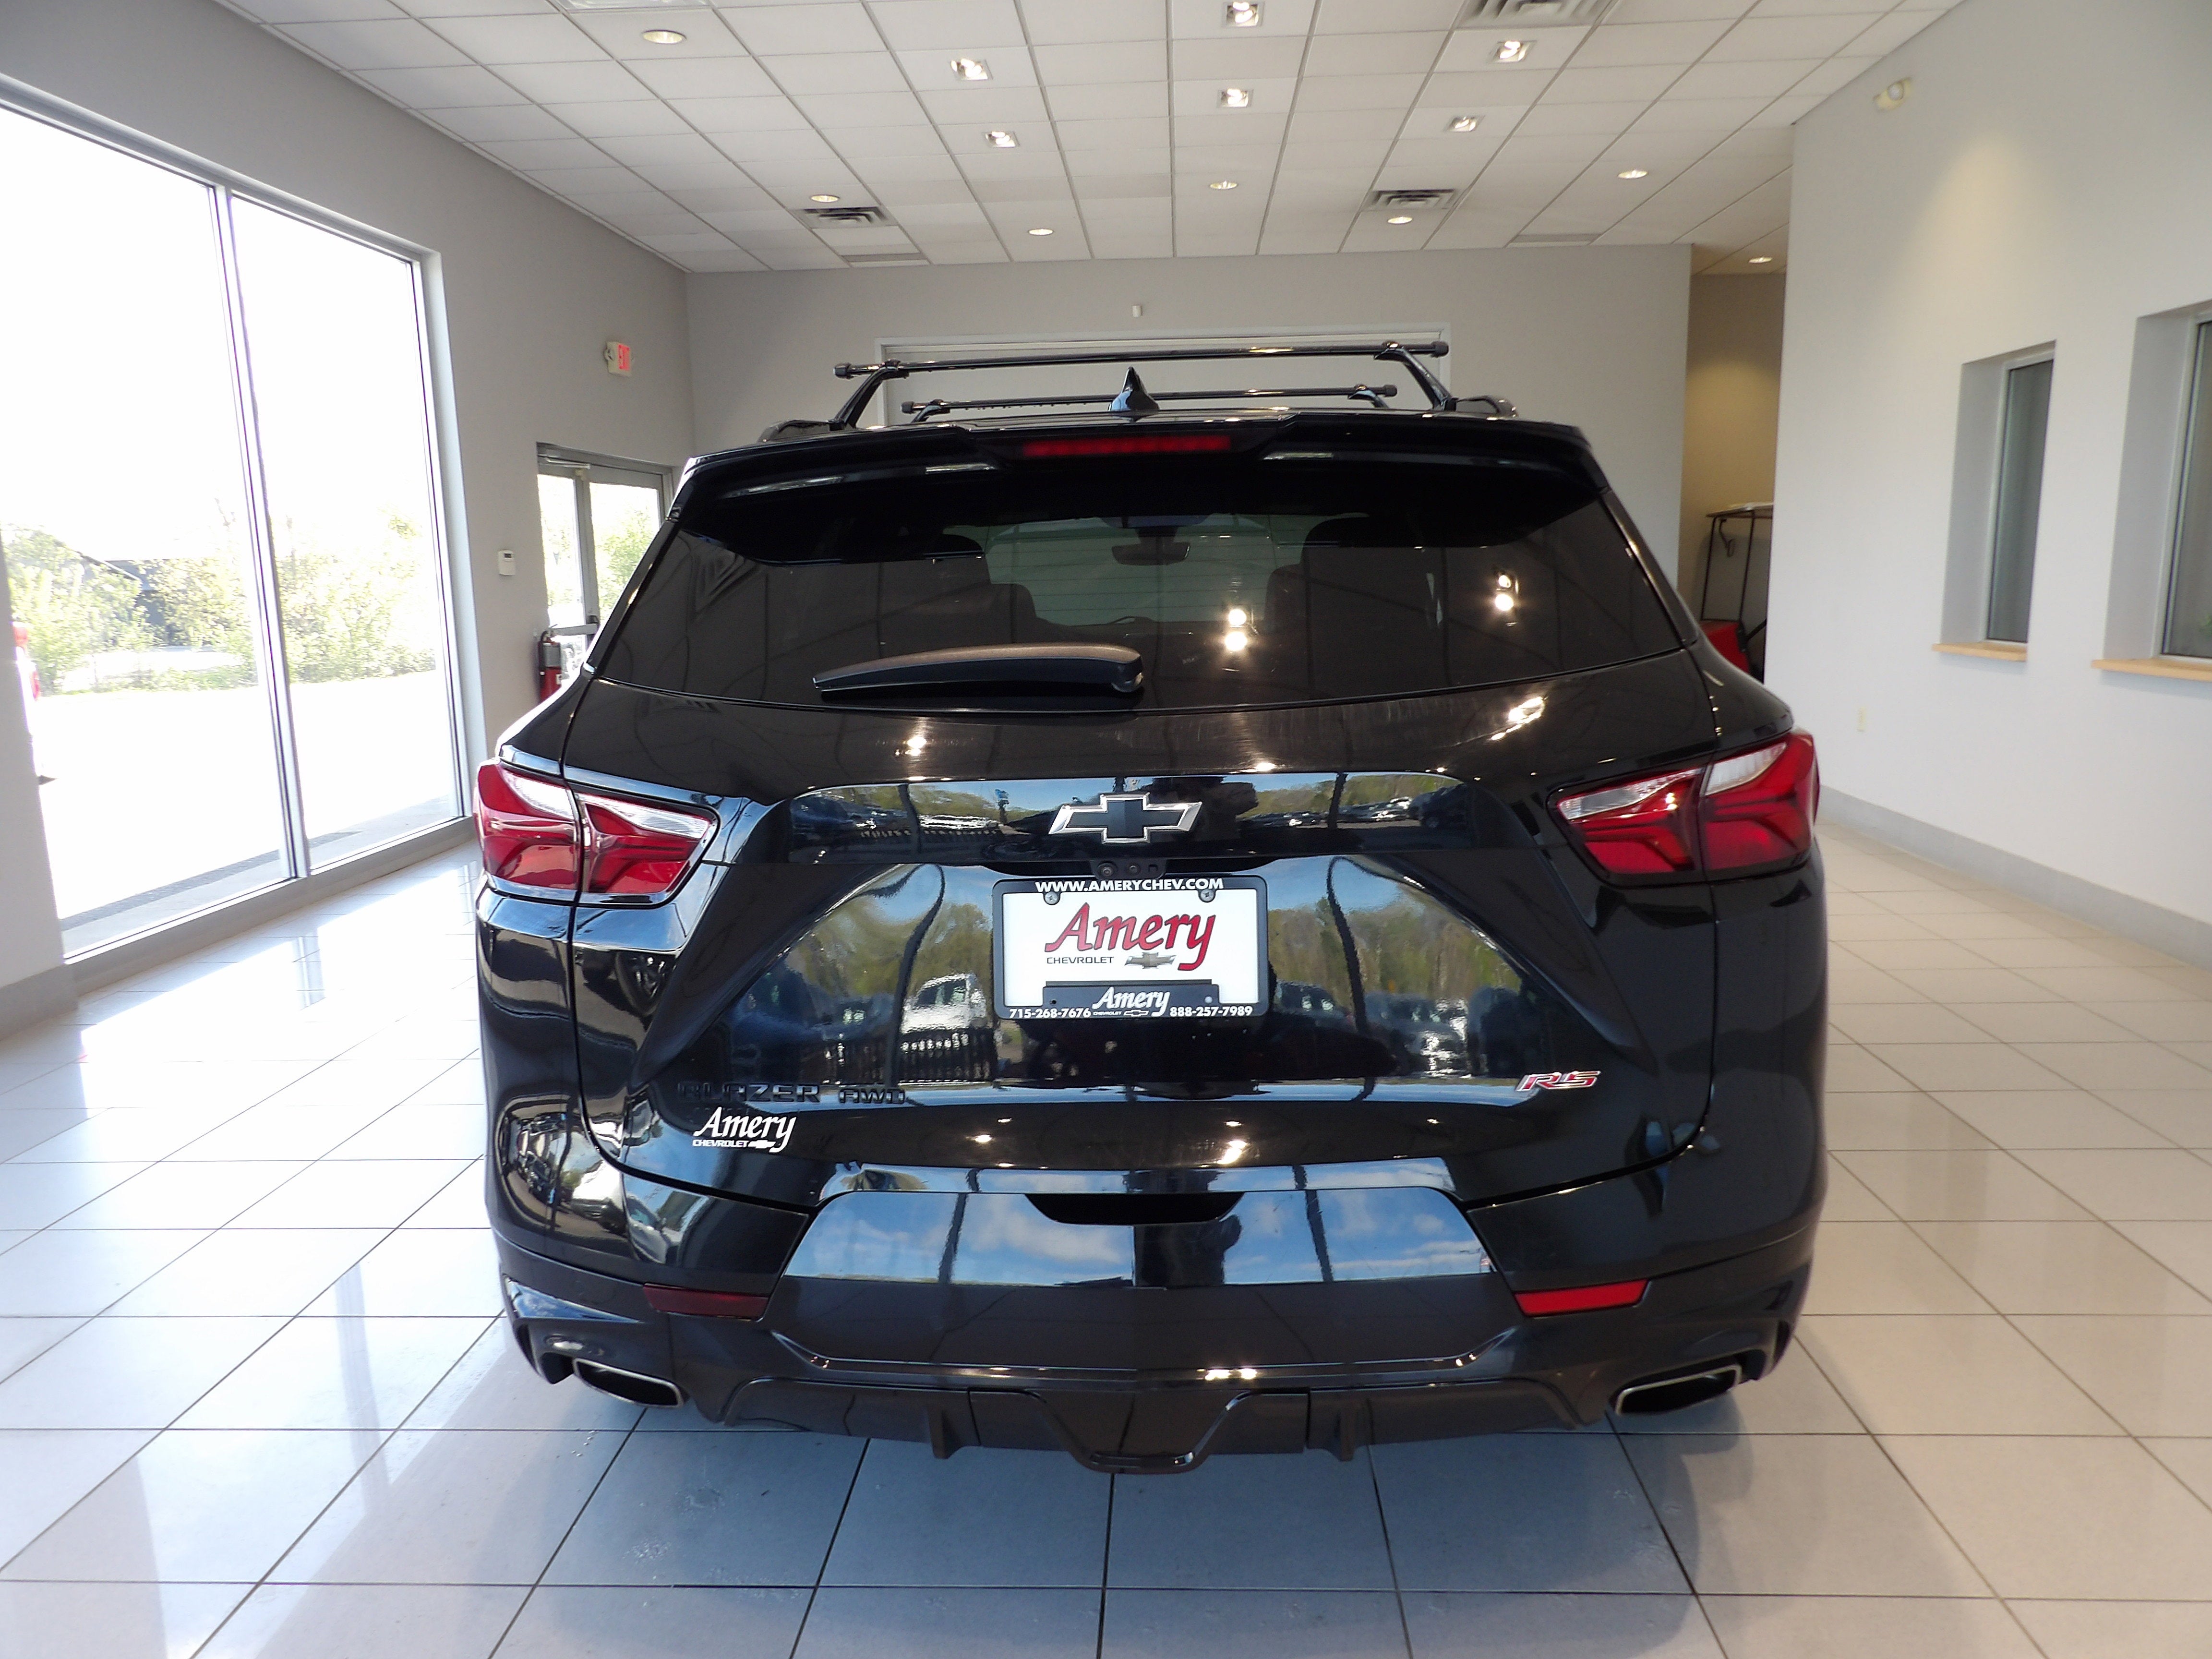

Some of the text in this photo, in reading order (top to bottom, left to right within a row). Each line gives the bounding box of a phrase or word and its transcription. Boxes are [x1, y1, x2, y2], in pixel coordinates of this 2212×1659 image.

[1035, 878, 1224, 891] WWW.AMERYCHEV.COM
[1044, 902, 1216, 971] Amery
[1092, 986, 1170, 1017] Amery
[1010, 1008, 1091, 1018] 715-268-7676
[1170, 1006, 1252, 1016] 888-257-7989
[1516, 1071, 1601, 1091] RS
[840, 1089, 905, 1104] AWD
[694, 1106, 797, 1153] Amery
